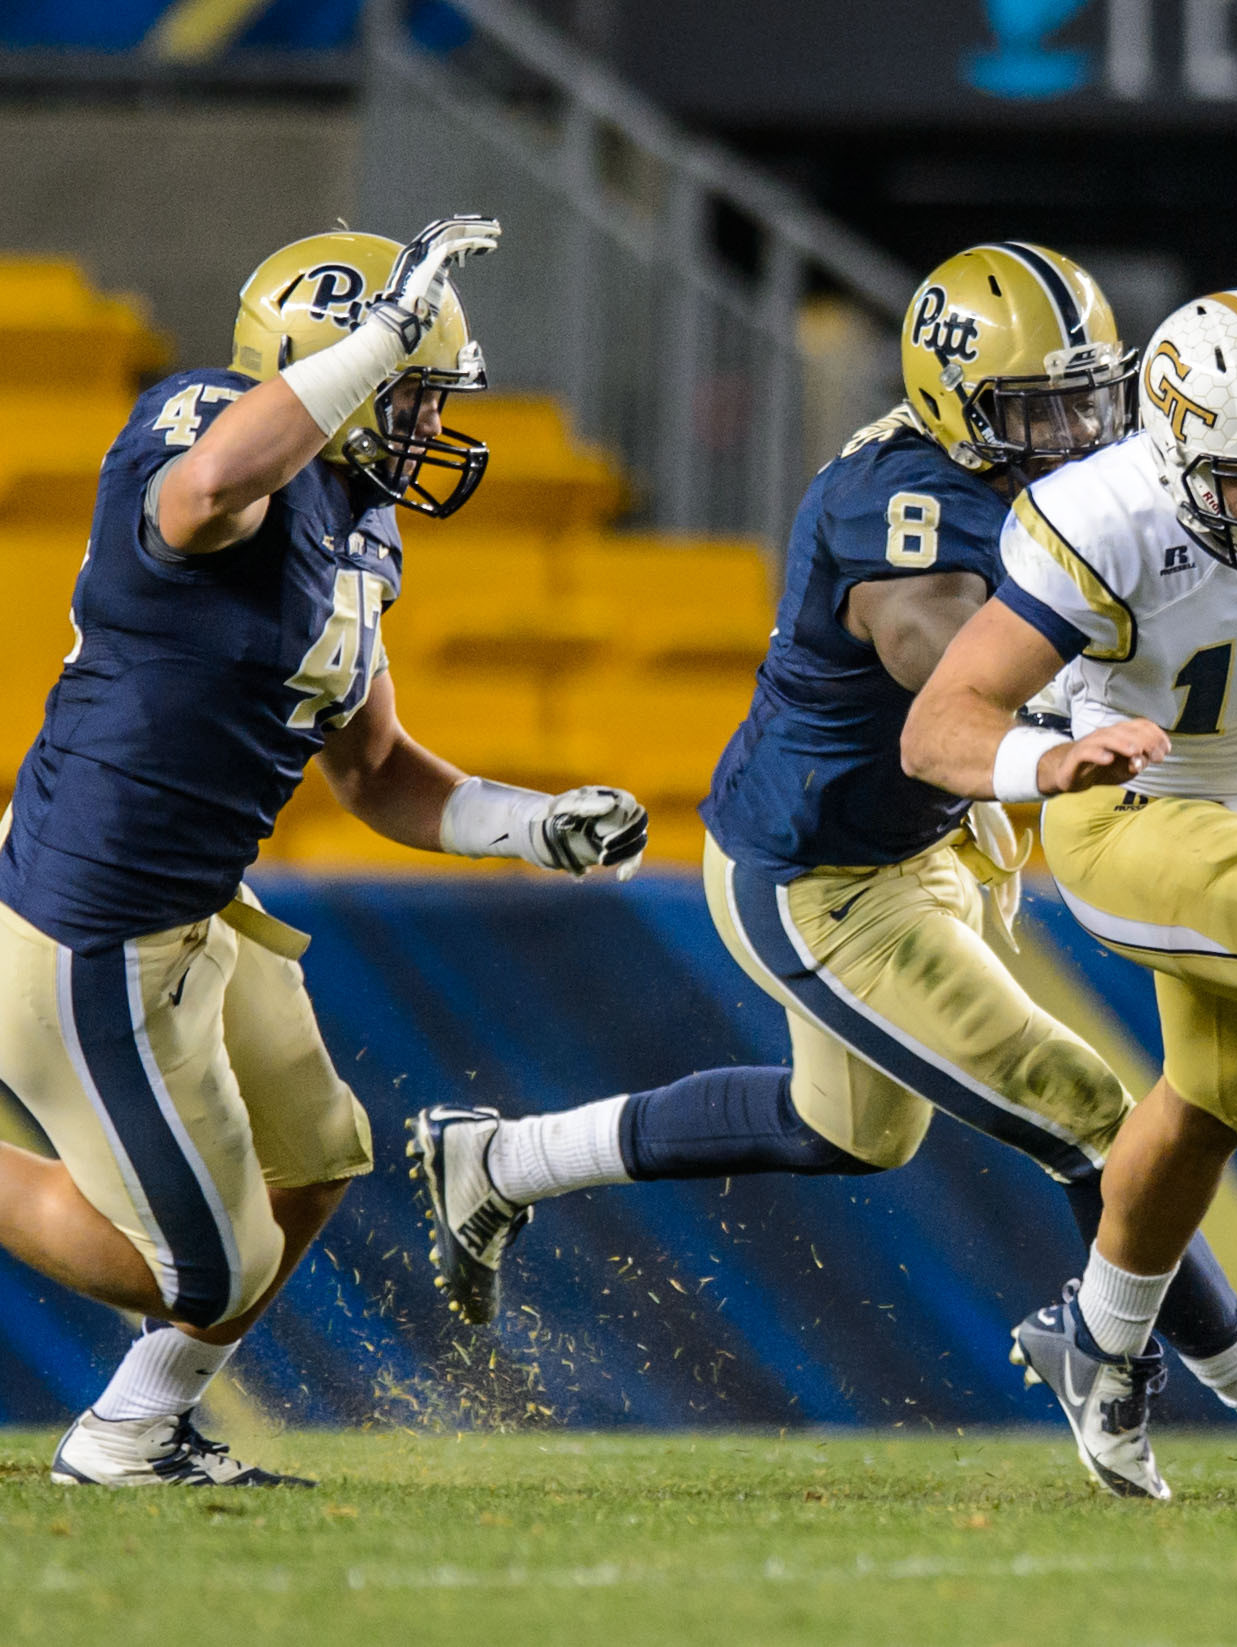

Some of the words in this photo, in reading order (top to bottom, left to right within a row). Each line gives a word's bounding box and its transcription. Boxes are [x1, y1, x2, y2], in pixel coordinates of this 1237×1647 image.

[305, 262, 385, 333] Pi
[911, 284, 979, 363] Pitt
[885, 491, 941, 569] 8
[283, 568, 399, 730] 47
